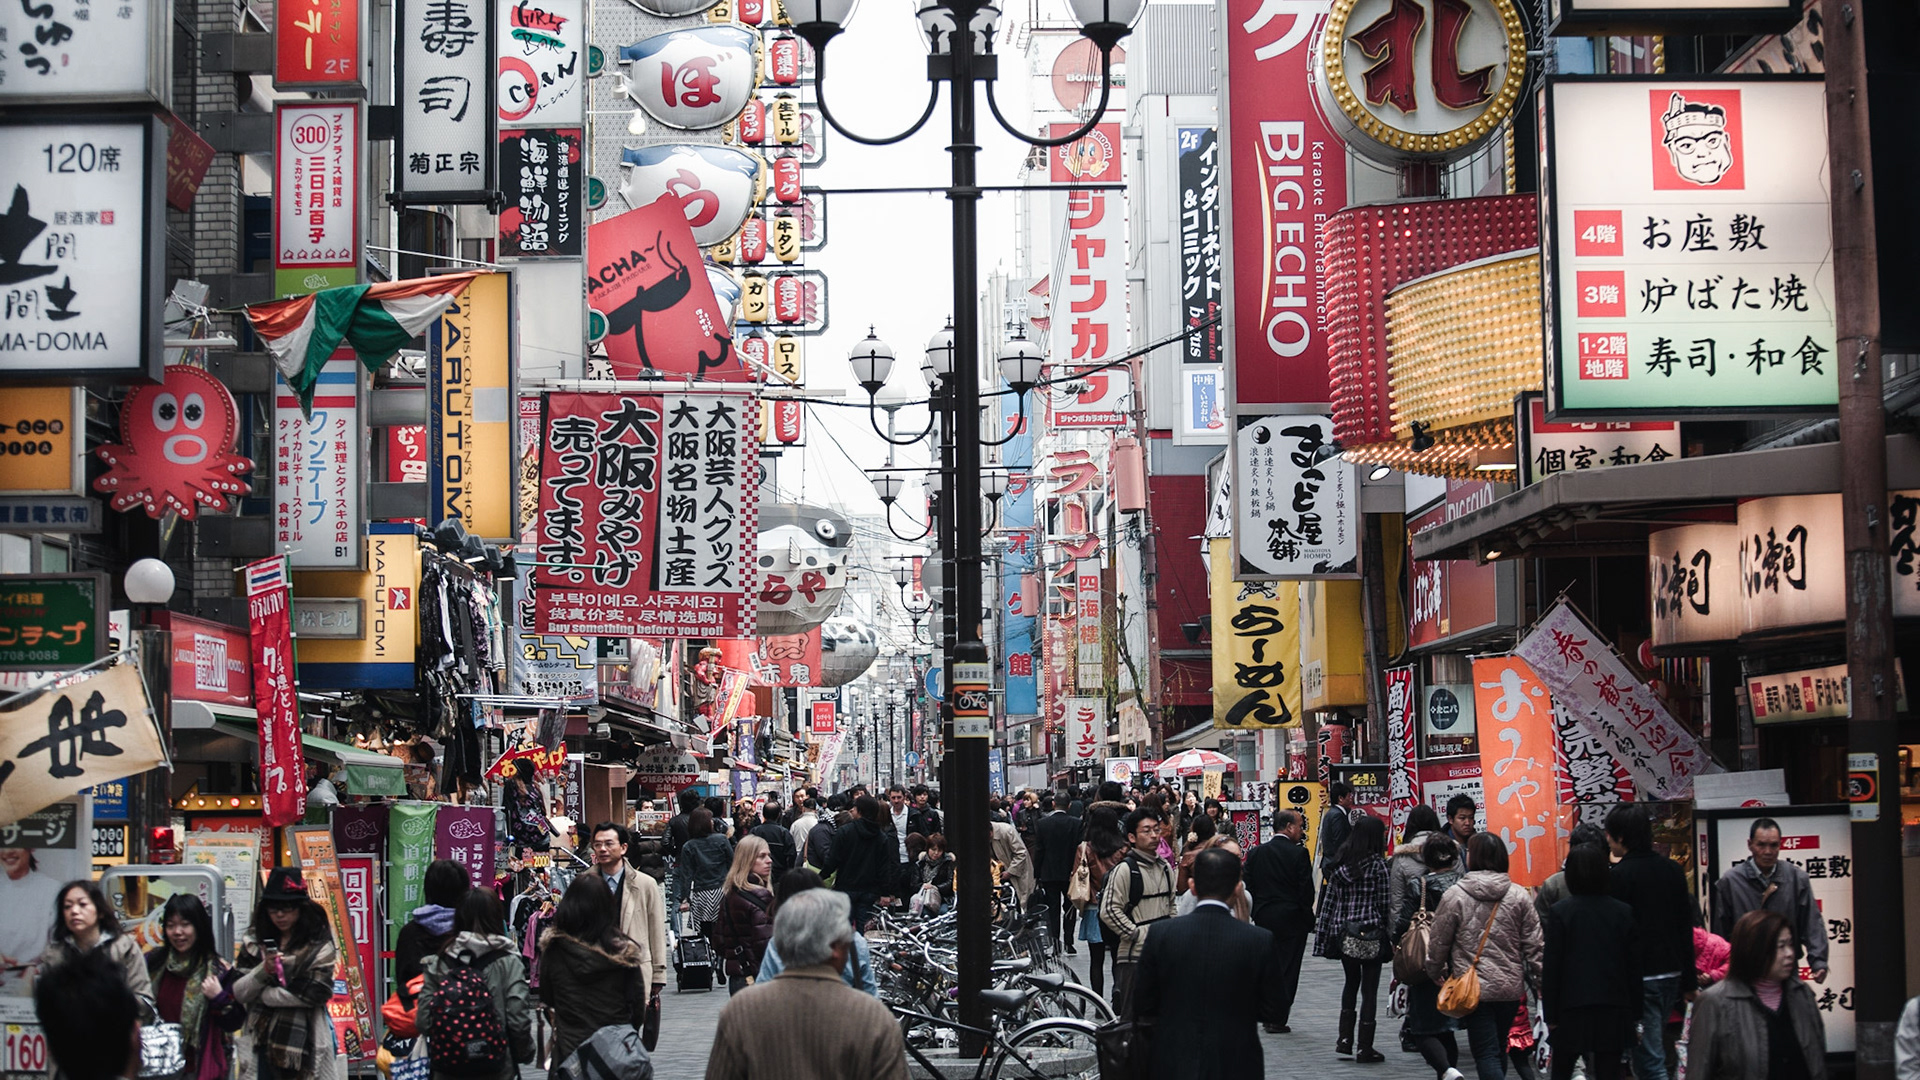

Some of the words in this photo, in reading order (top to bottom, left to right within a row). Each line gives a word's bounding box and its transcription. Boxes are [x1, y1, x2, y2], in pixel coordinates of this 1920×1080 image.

[294, 0, 322, 70] ラー
[325, 59, 350, 74] 2F
[295, 126, 326, 143] 300
[778, 102, 795, 136] 生ビール
[1181, 131, 1198, 149] 2F
[409, 151, 480, 175] 菊正宗
[779, 163, 797, 195] ユッケ
[1260, 121, 1304, 210] BIG
[1312, 141, 1325, 206] Karaoke
[308, 156, 327, 245] 三日月百子
[520, 138, 550, 250] 海鮮物語
[777, 221, 793, 256] 牛タン
[1581, 225, 1616, 243] 4階
[1642, 212, 1768, 252] お座敷
[1266, 222, 1311, 357] ECHO
[1314, 213, 1328, 332] Entertainment
[463, 288, 471, 319] CITY
[748, 282, 766, 313] ガツ
[1584, 286, 1619, 304] 3階
[1640, 273, 1810, 314] 炉ばた焼
[463, 326, 472, 418] DISCOUNT
[779, 342, 796, 376] ロース
[1585, 359, 1624, 378] 地階
[781, 402, 797, 437] カシラ
[1200, 386, 1209, 422] くいだおれ
[279, 420, 289, 486] タイ調味料
[463, 424, 472, 471] MEN'S
[293, 419, 302, 542] タイカルチャースクール
[308, 411, 327, 525] クンテープ
[335, 419, 347, 542] タイ料理とタイスキの店
[463, 481, 472, 529] SHOP
[592, 398, 660, 587] 大阪みやげ
[664, 401, 700, 588] 大阪名物土産
[702, 401, 737, 588] 大阪芸人グッズ
[279, 503, 289, 542] 食材店
[335, 547, 348, 557] B1
[300, 609, 352, 628] 松ビル
[375, 541, 386, 657] MARUTOMI
[549, 622, 571, 634] Buy
[572, 623, 635, 635] something
[637, 623, 675, 635] before
[678, 625, 699, 636] you
[761, 663, 811, 685] 赤鬼
[1225, 605, 1292, 726] らーめん
[1076, 707, 1097, 758] ラーメン
[501, 746, 565, 777] おやげ
[1480, 668, 1550, 874] おみやげ
[1783, 838, 1800, 848] 4F
[7, 1034, 46, 1070] 160
